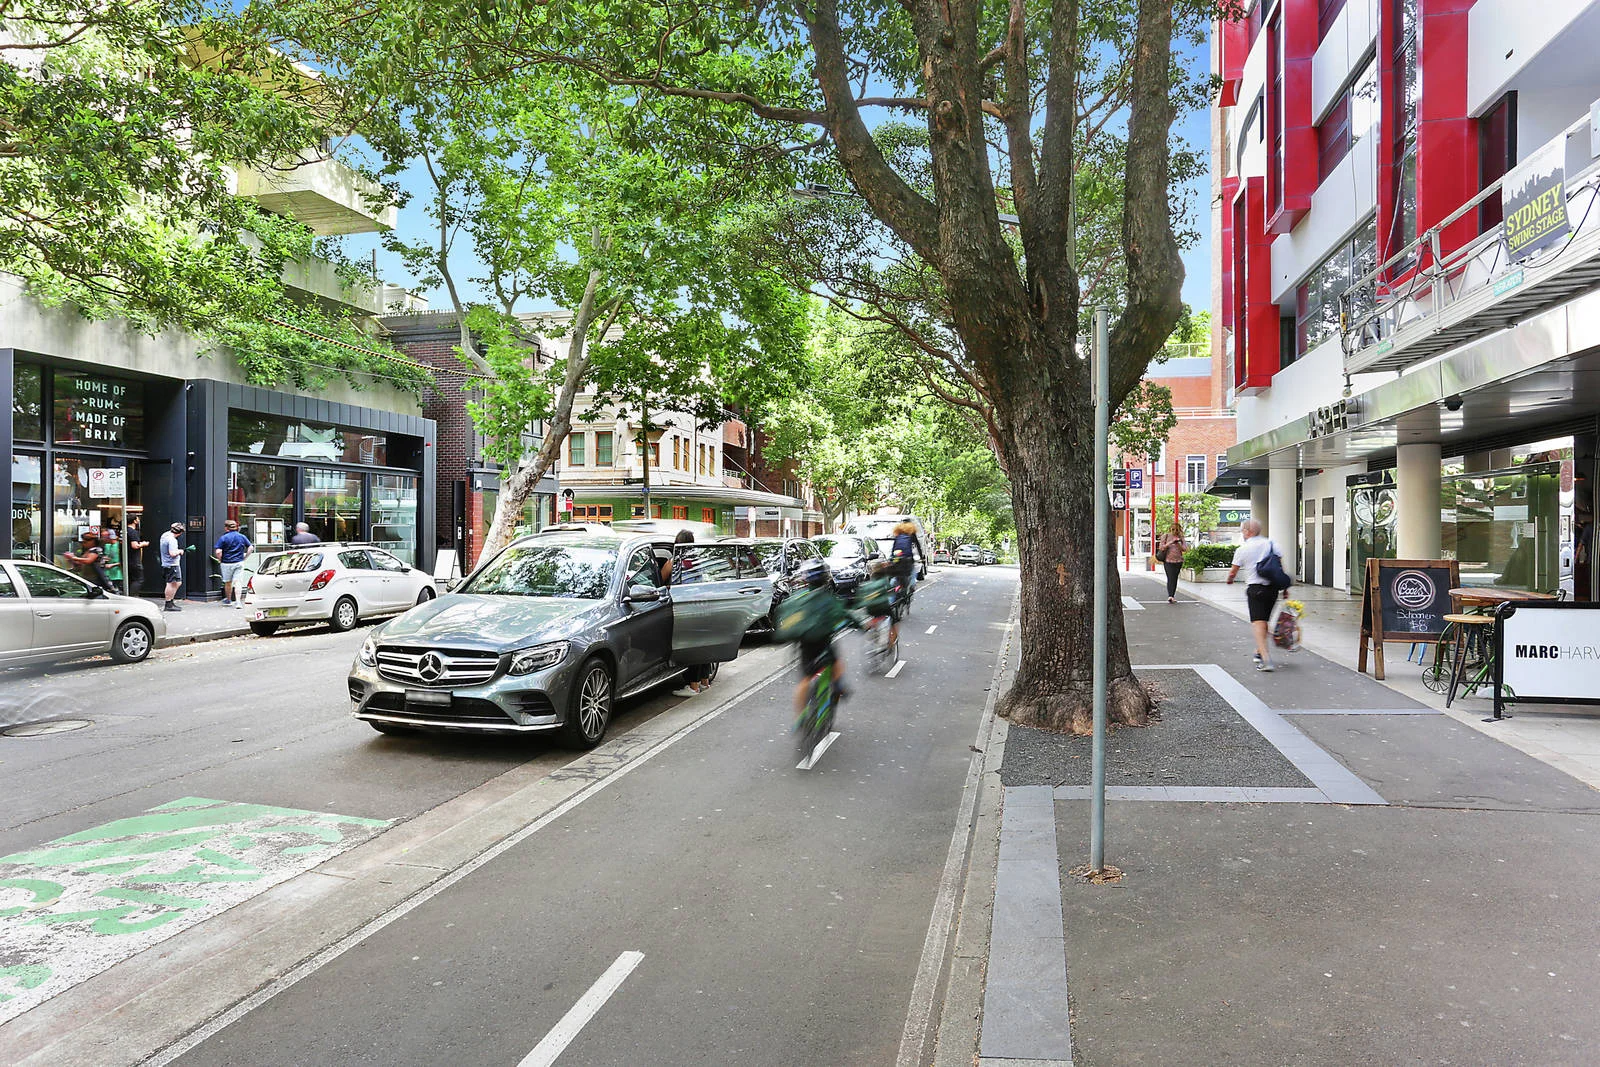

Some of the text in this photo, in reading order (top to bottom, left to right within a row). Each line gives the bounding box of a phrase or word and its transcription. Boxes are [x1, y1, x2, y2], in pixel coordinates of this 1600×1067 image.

[1507, 183, 1562, 236] SYDNEY
[1508, 206, 1566, 250] SWING STAGE
[76, 380, 126, 396] HOME OF
[76, 411, 126, 427] MADE OF
[85, 428, 117, 441] BRIX
[109, 471, 124, 479] 2P
[1133, 472, 1140, 480] P
[1396, 609, 1436, 620] Schooner
[1410, 619, 1428, 632] $8
